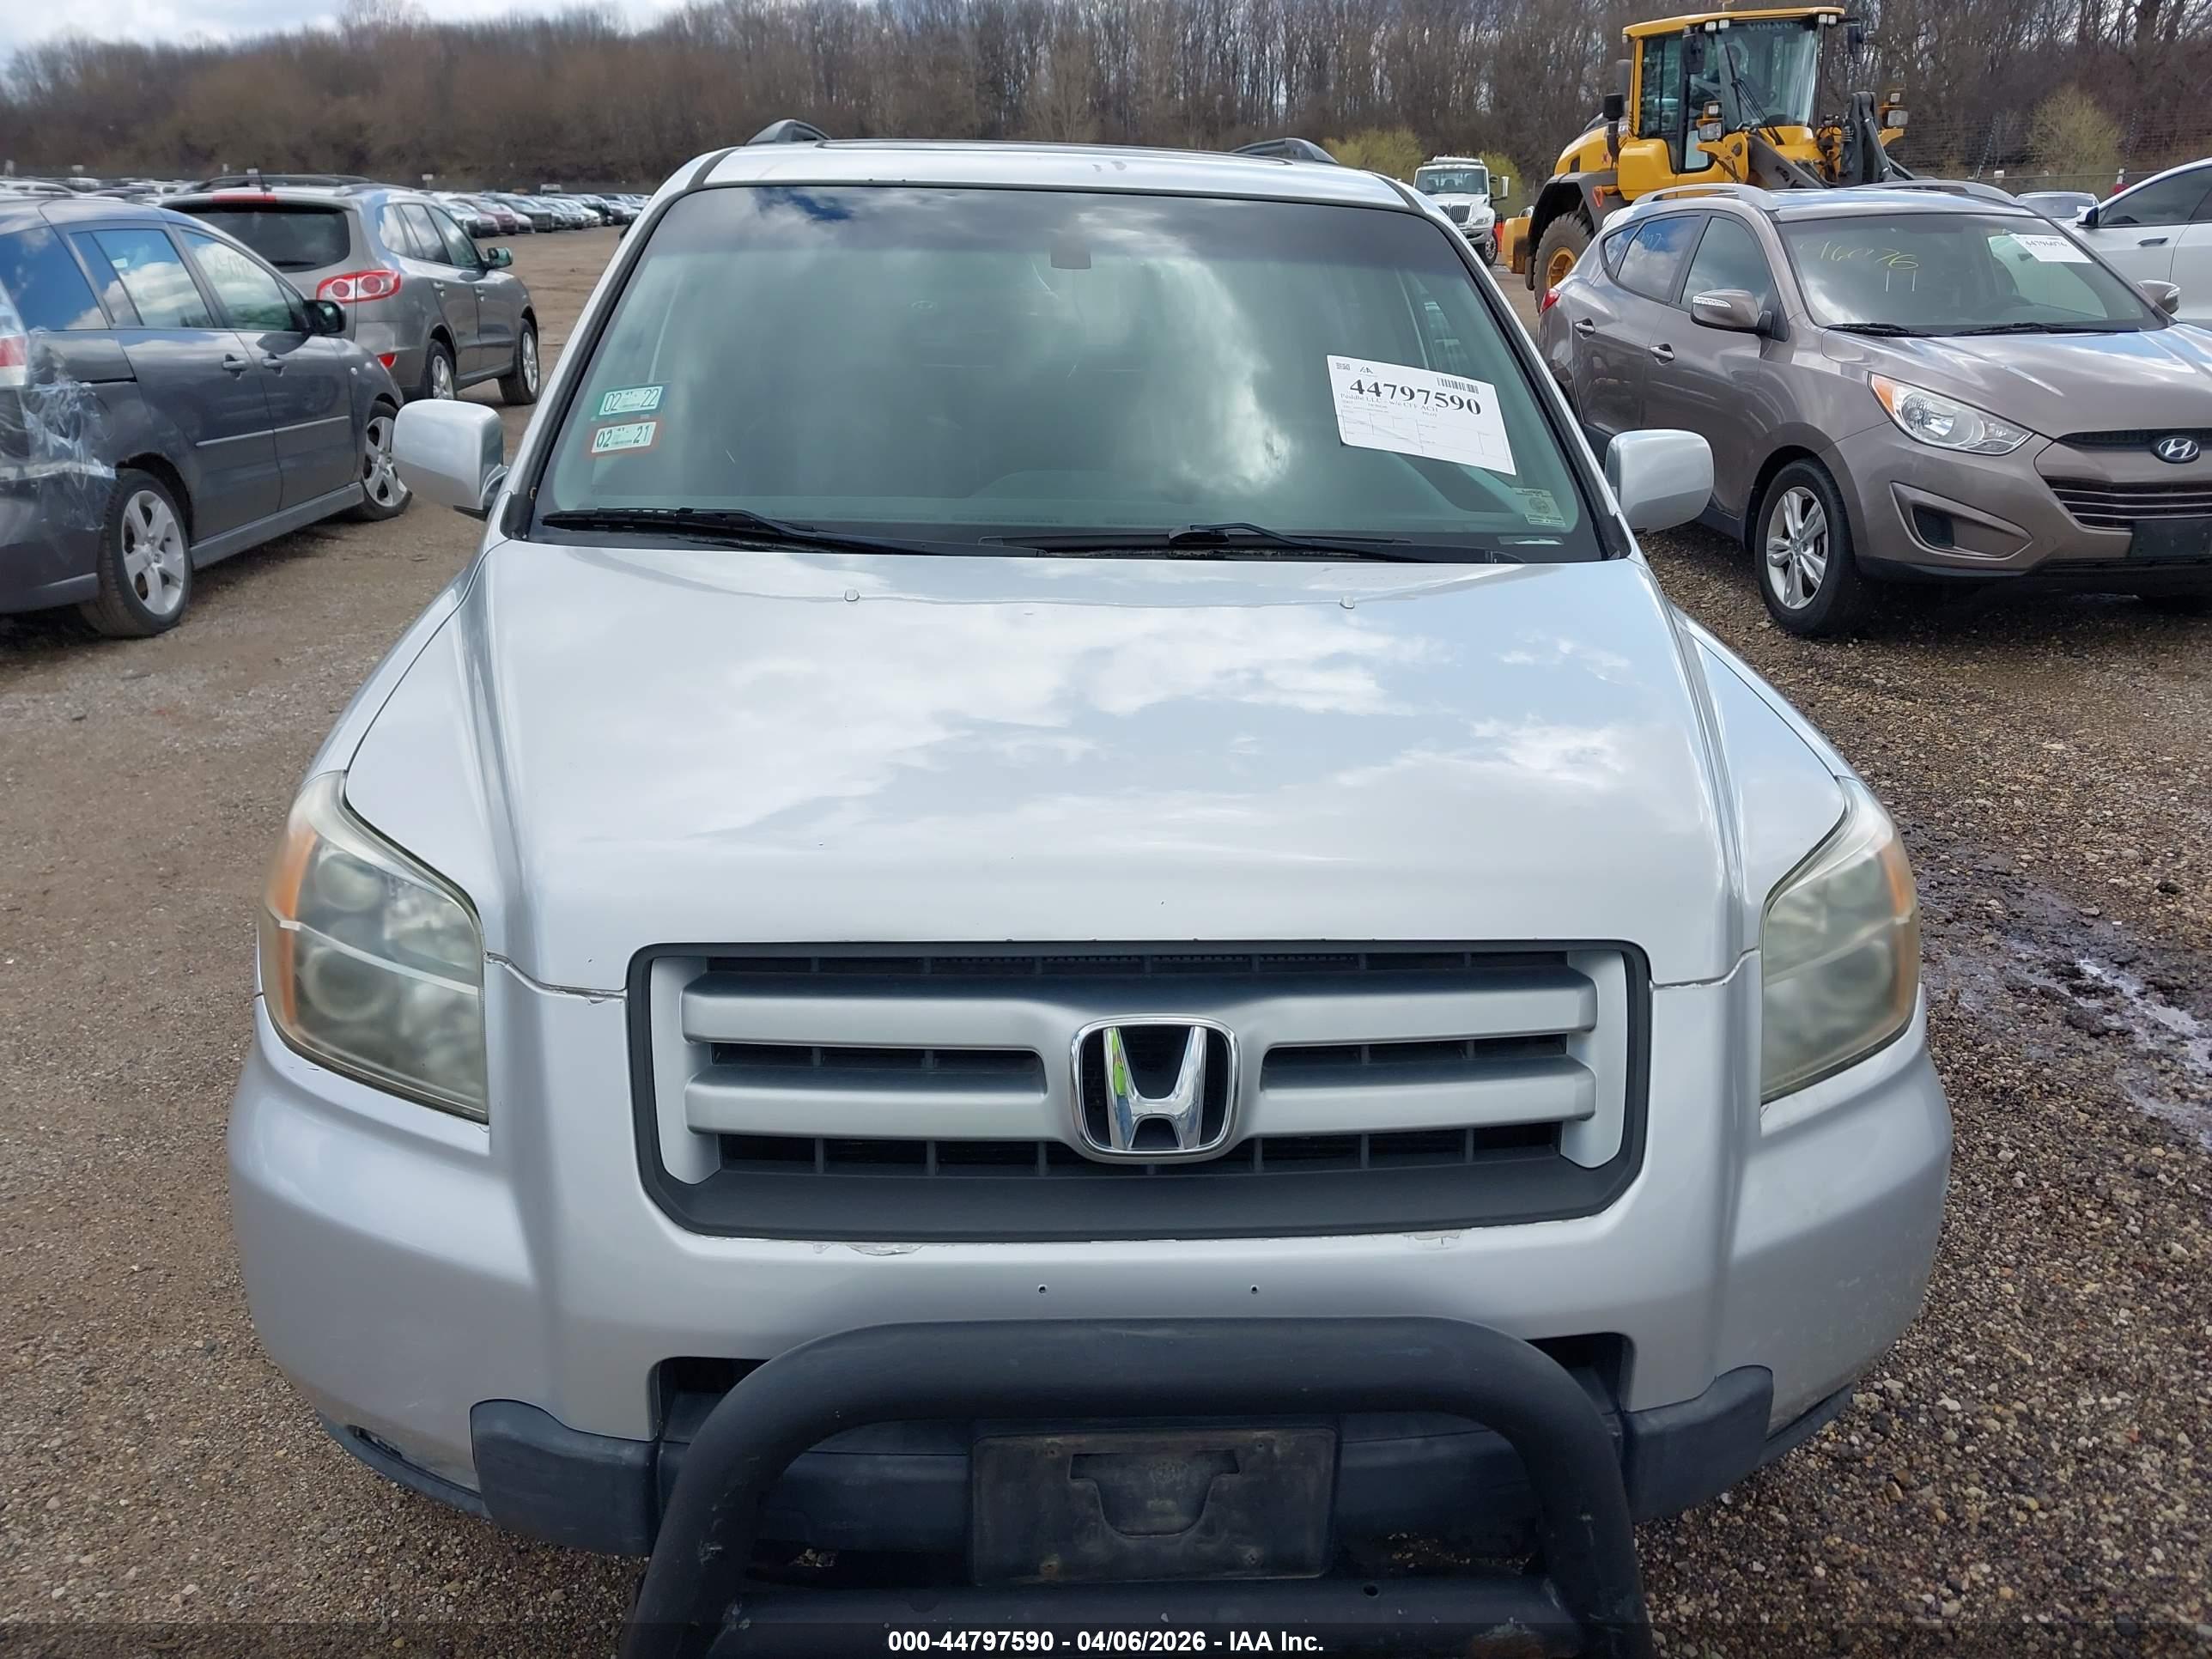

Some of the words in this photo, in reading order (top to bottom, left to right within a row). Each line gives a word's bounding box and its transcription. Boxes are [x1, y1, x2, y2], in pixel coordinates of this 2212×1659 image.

[1747, 21, 1794, 32] VOLVO
[605, 392, 622, 411] 02
[640, 388, 659, 407] 22
[1349, 379, 1482, 416] 44797590
[596, 429, 613, 447] 02
[633, 425, 650, 444] 21
